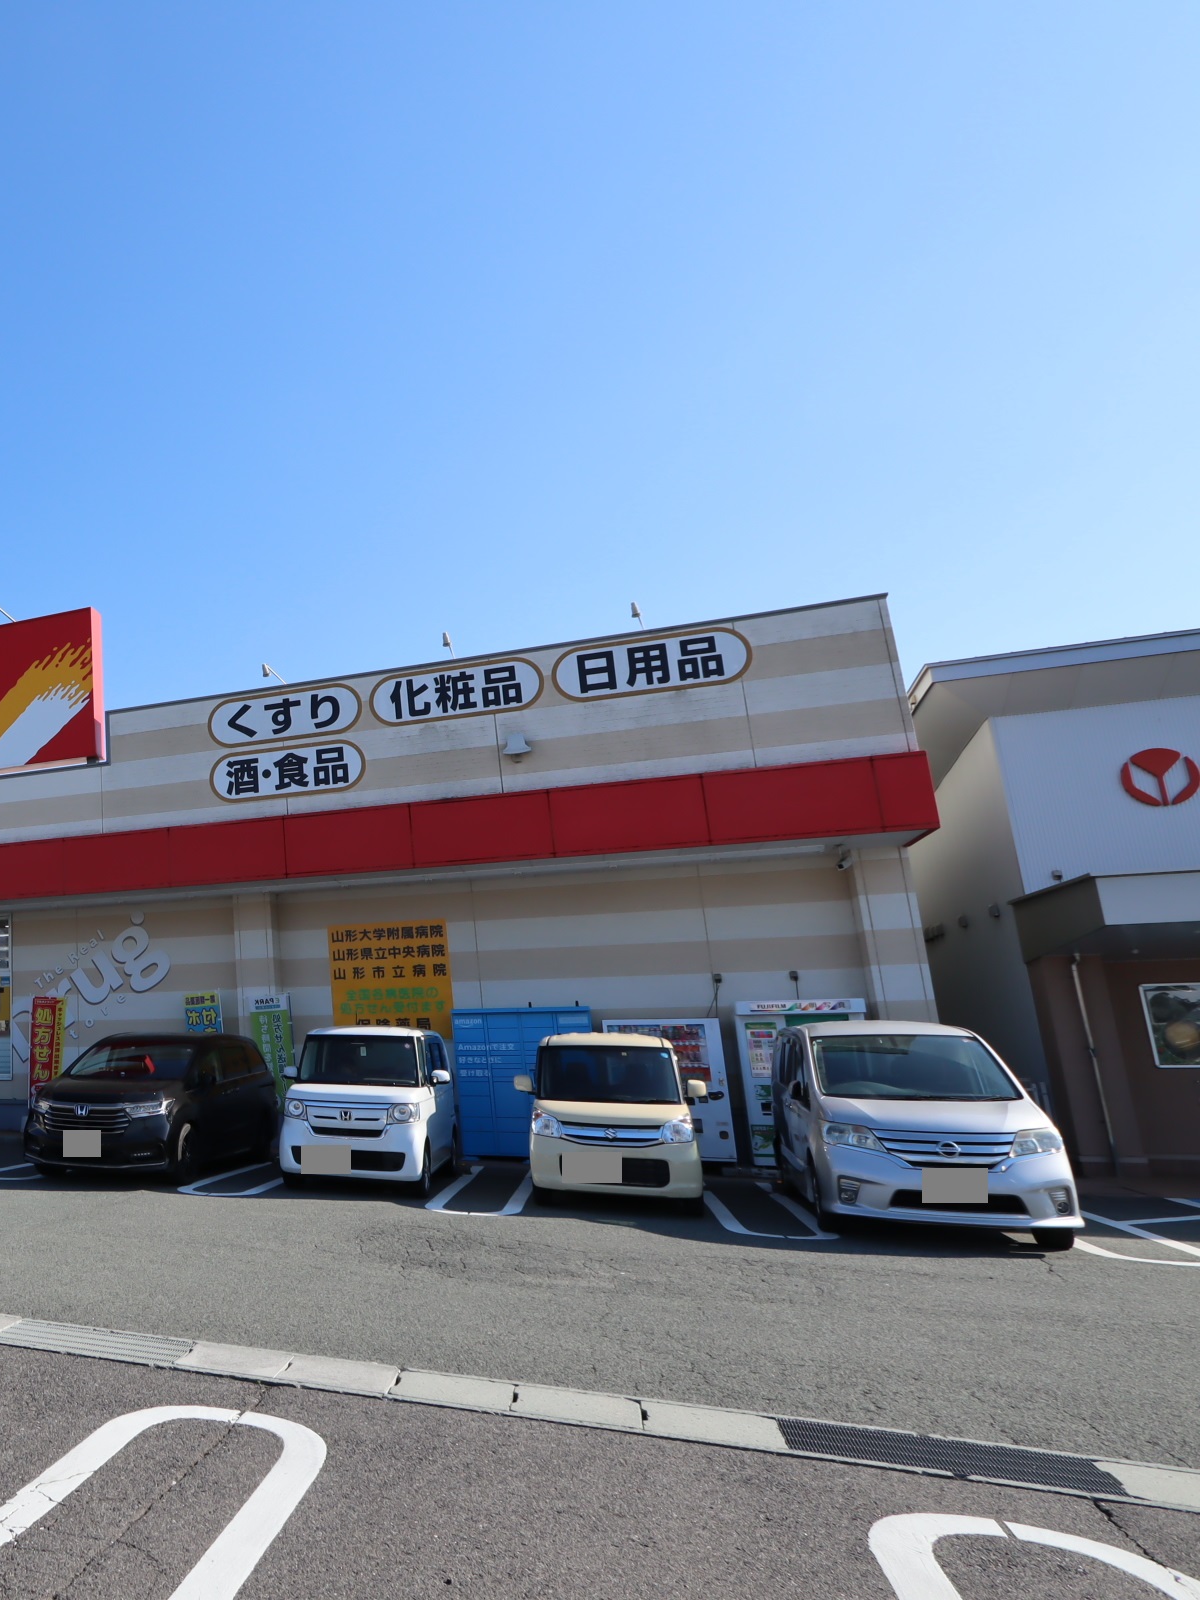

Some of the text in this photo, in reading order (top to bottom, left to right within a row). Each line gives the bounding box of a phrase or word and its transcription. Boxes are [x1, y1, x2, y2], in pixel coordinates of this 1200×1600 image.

[576, 635, 725, 694] 日用品
[226, 693, 341, 738] くすり
[390, 665, 524, 720] 化粧品
[226, 746, 350, 796] 酒・食品
[331, 924, 444, 943] 山形大学附属病院
[332, 943, 446, 961] 山形県立中央病院
[34, 928, 105, 989] The Real
[333, 963, 447, 980] 山形市立病院
[33, 1008, 54, 1081] 処方せん
[454, 1018, 482, 1026] amazon
